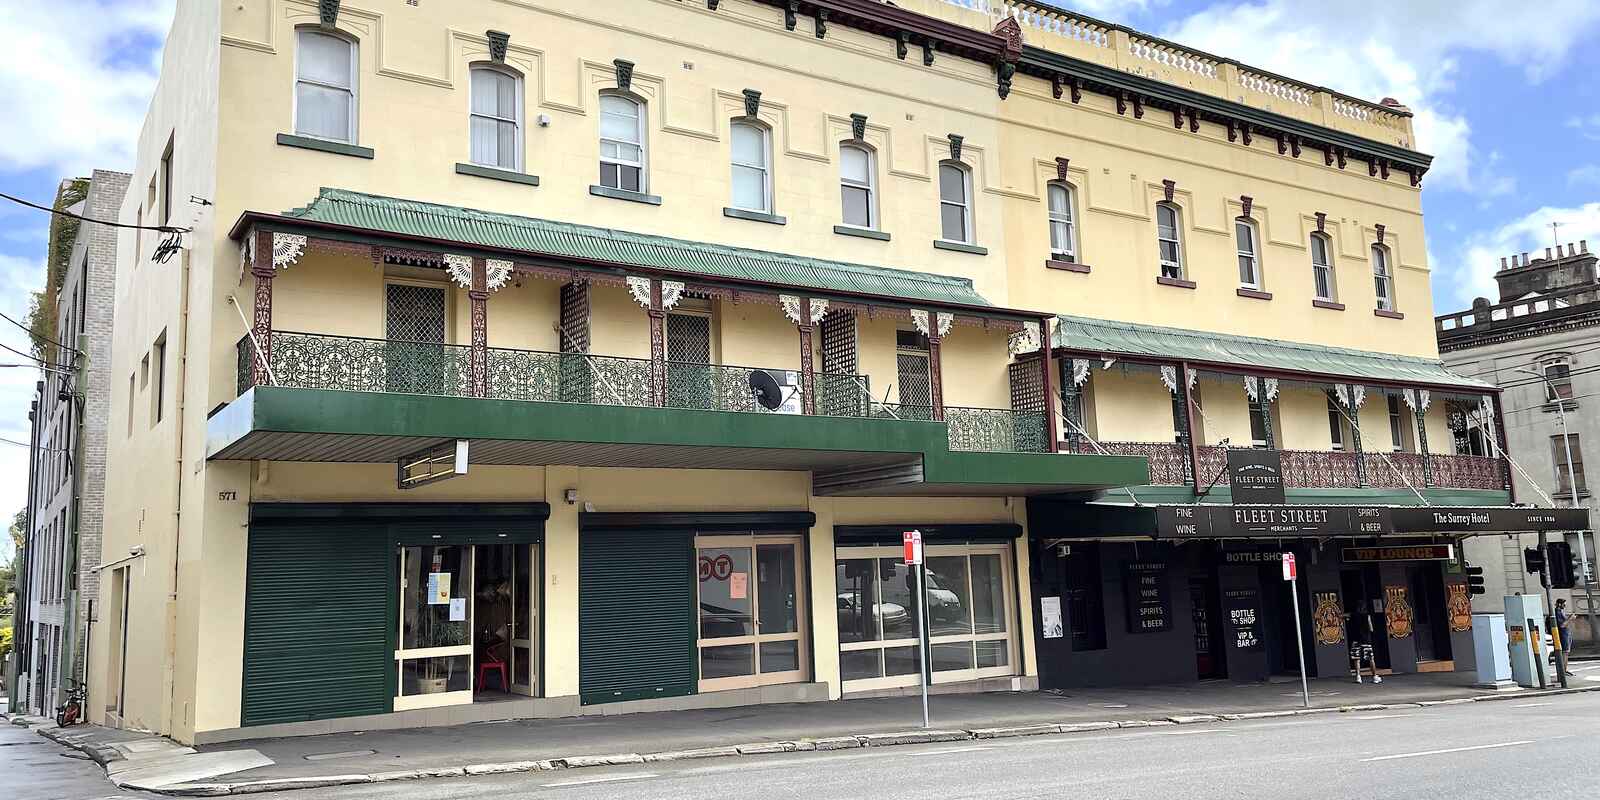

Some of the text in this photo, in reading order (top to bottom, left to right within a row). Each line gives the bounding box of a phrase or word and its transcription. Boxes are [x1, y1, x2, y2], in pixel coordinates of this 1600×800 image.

[218, 491, 236, 501] 571
[1176, 508, 1193, 518] FINE
[1235, 509, 1328, 523] FLEET STREET
[1358, 508, 1380, 517] SPIRITS
[1433, 512, 1490, 526] The Surrey Hotel
[1175, 524, 1197, 534] WINE
[1360, 522, 1382, 532] & BEER
[1226, 552, 1261, 562] BOTTLE
[1263, 552, 1284, 562] SHO
[1378, 548, 1434, 560] LOUNGE
[1141, 576, 1159, 585] FINE
[1141, 589, 1159, 597] WINE
[1140, 607, 1163, 616] SPIRITS
[1231, 609, 1255, 618] BOTTLE
[1147, 619, 1163, 628] BEER
[1240, 617, 1256, 625] SHOP
[1237, 631, 1248, 640] VIP
[1237, 640, 1251, 648] BAR
